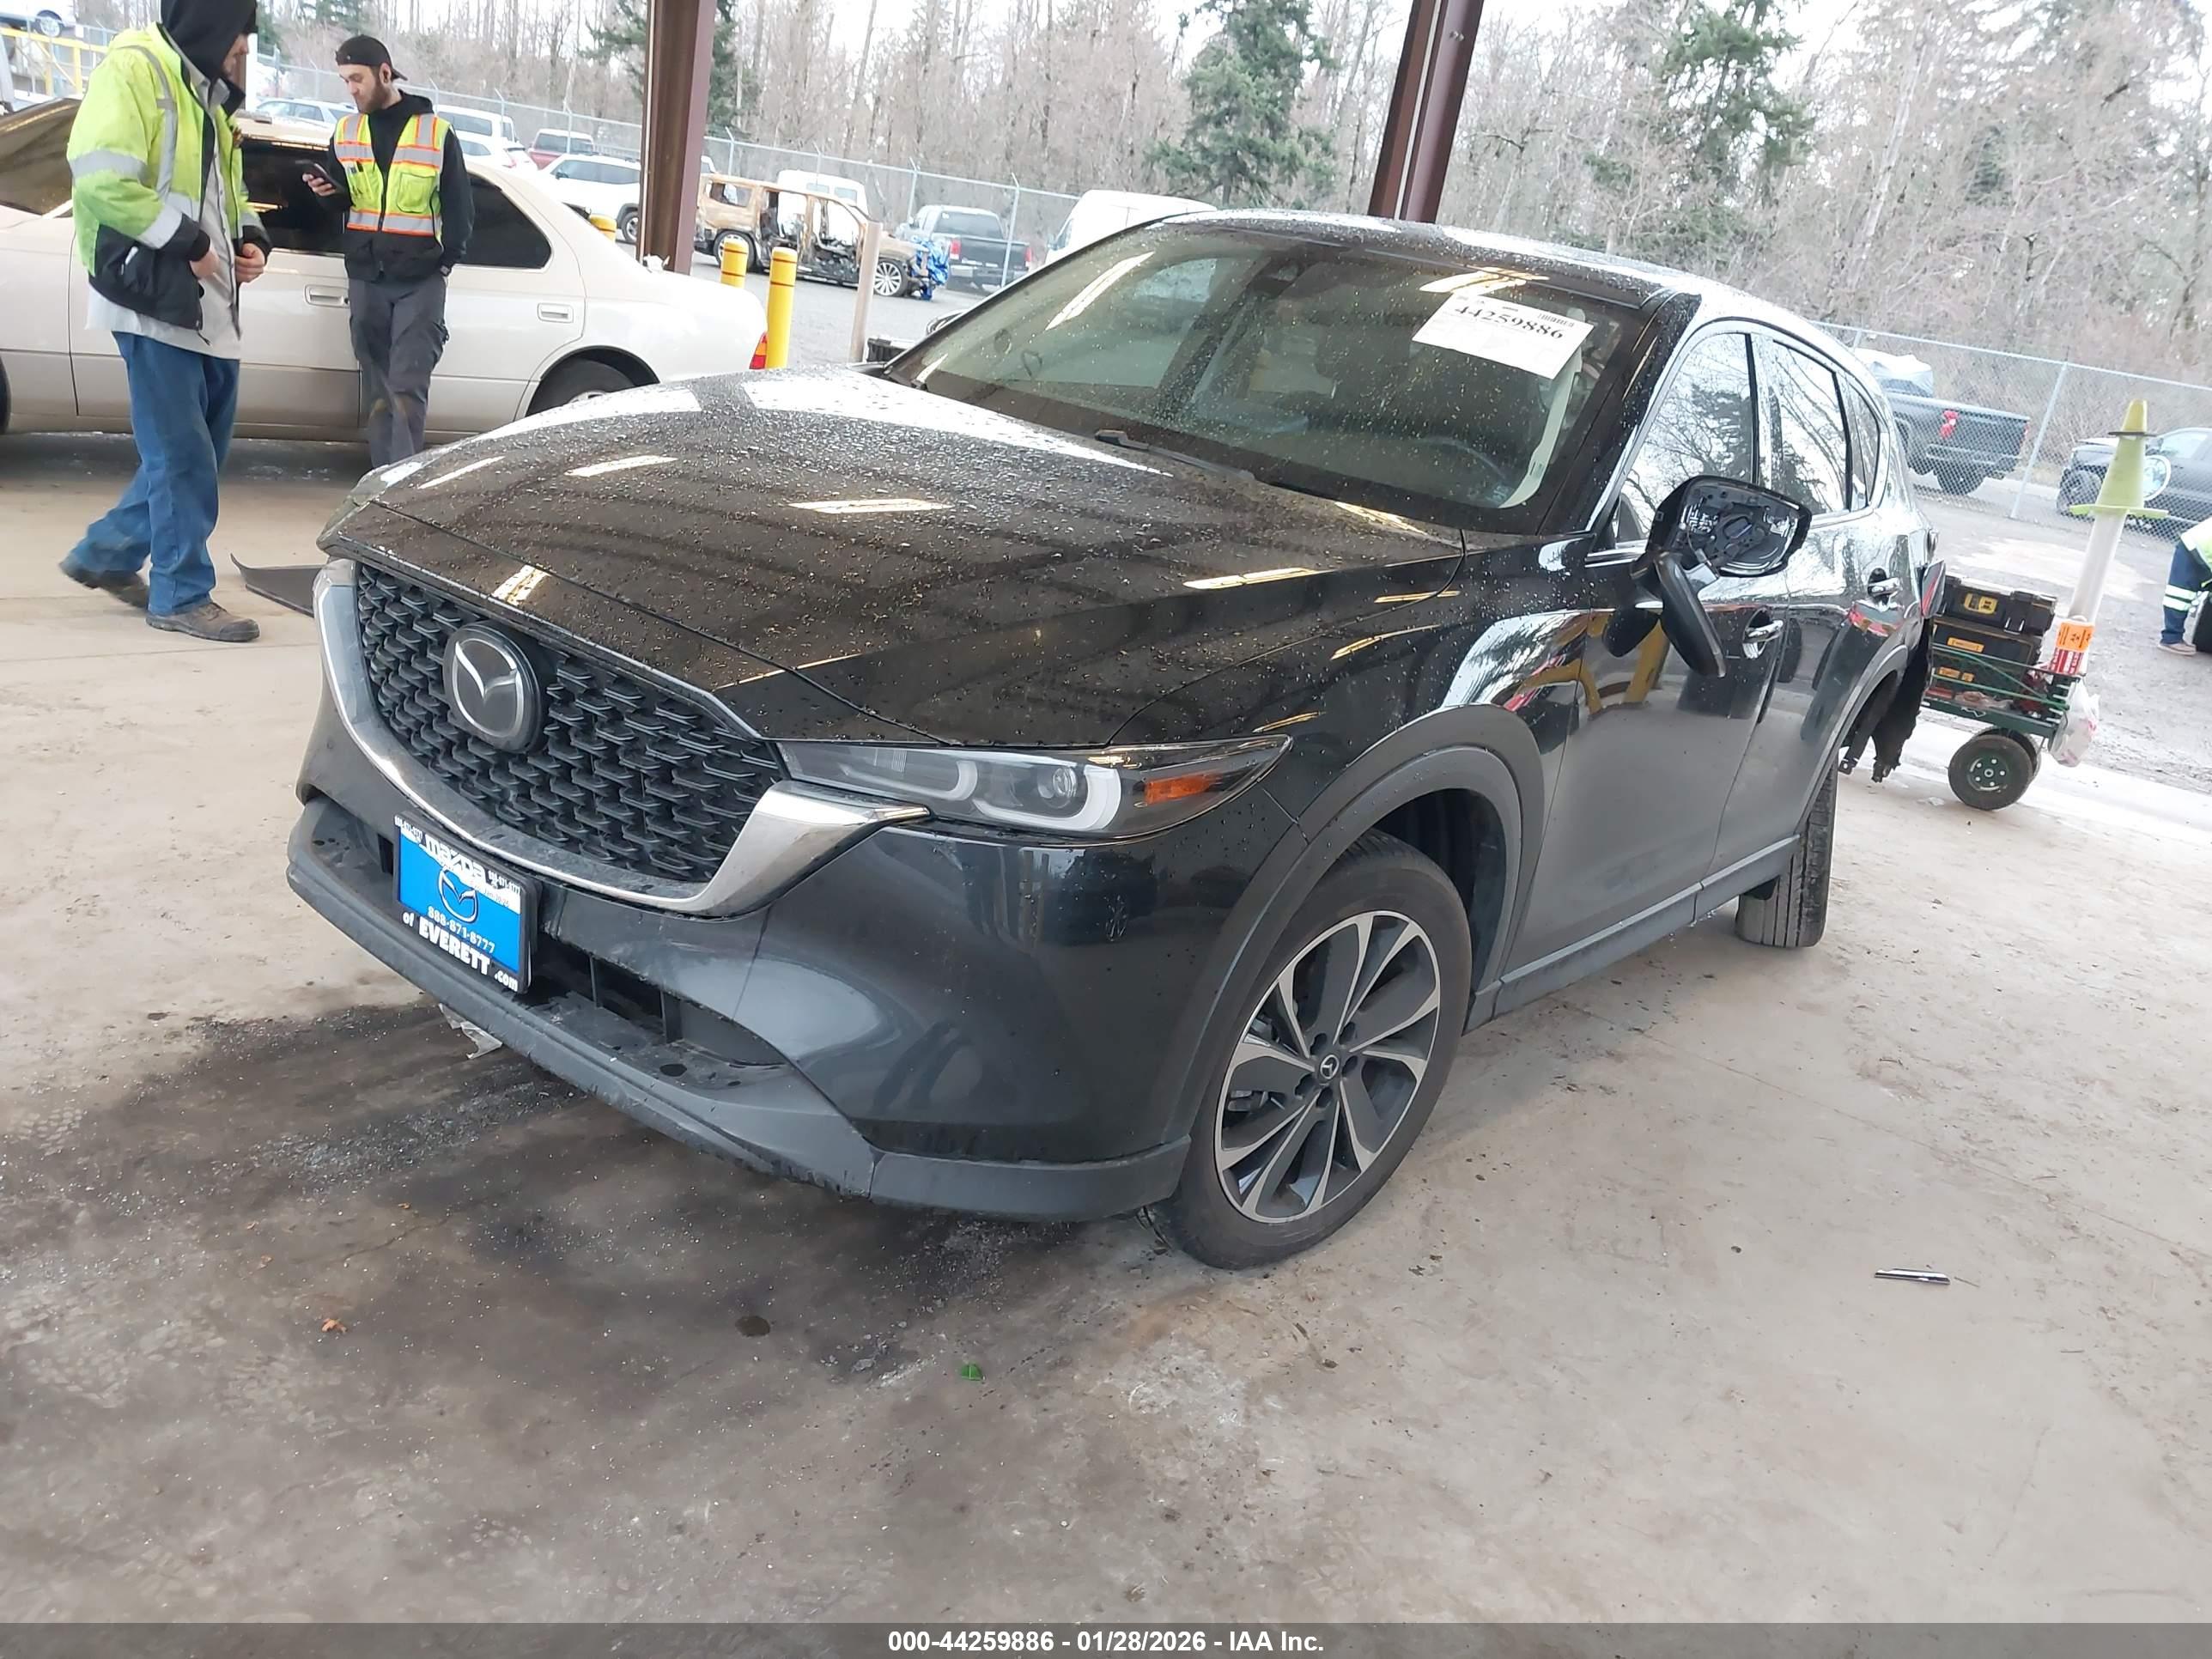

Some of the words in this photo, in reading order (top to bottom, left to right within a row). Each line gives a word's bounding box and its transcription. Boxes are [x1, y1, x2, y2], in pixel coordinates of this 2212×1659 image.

[1454, 305, 1565, 340] 44259886
[403, 912, 415, 927] of
[418, 916, 490, 975] EVERETT
[428, 905, 495, 953] 888-871-8777
